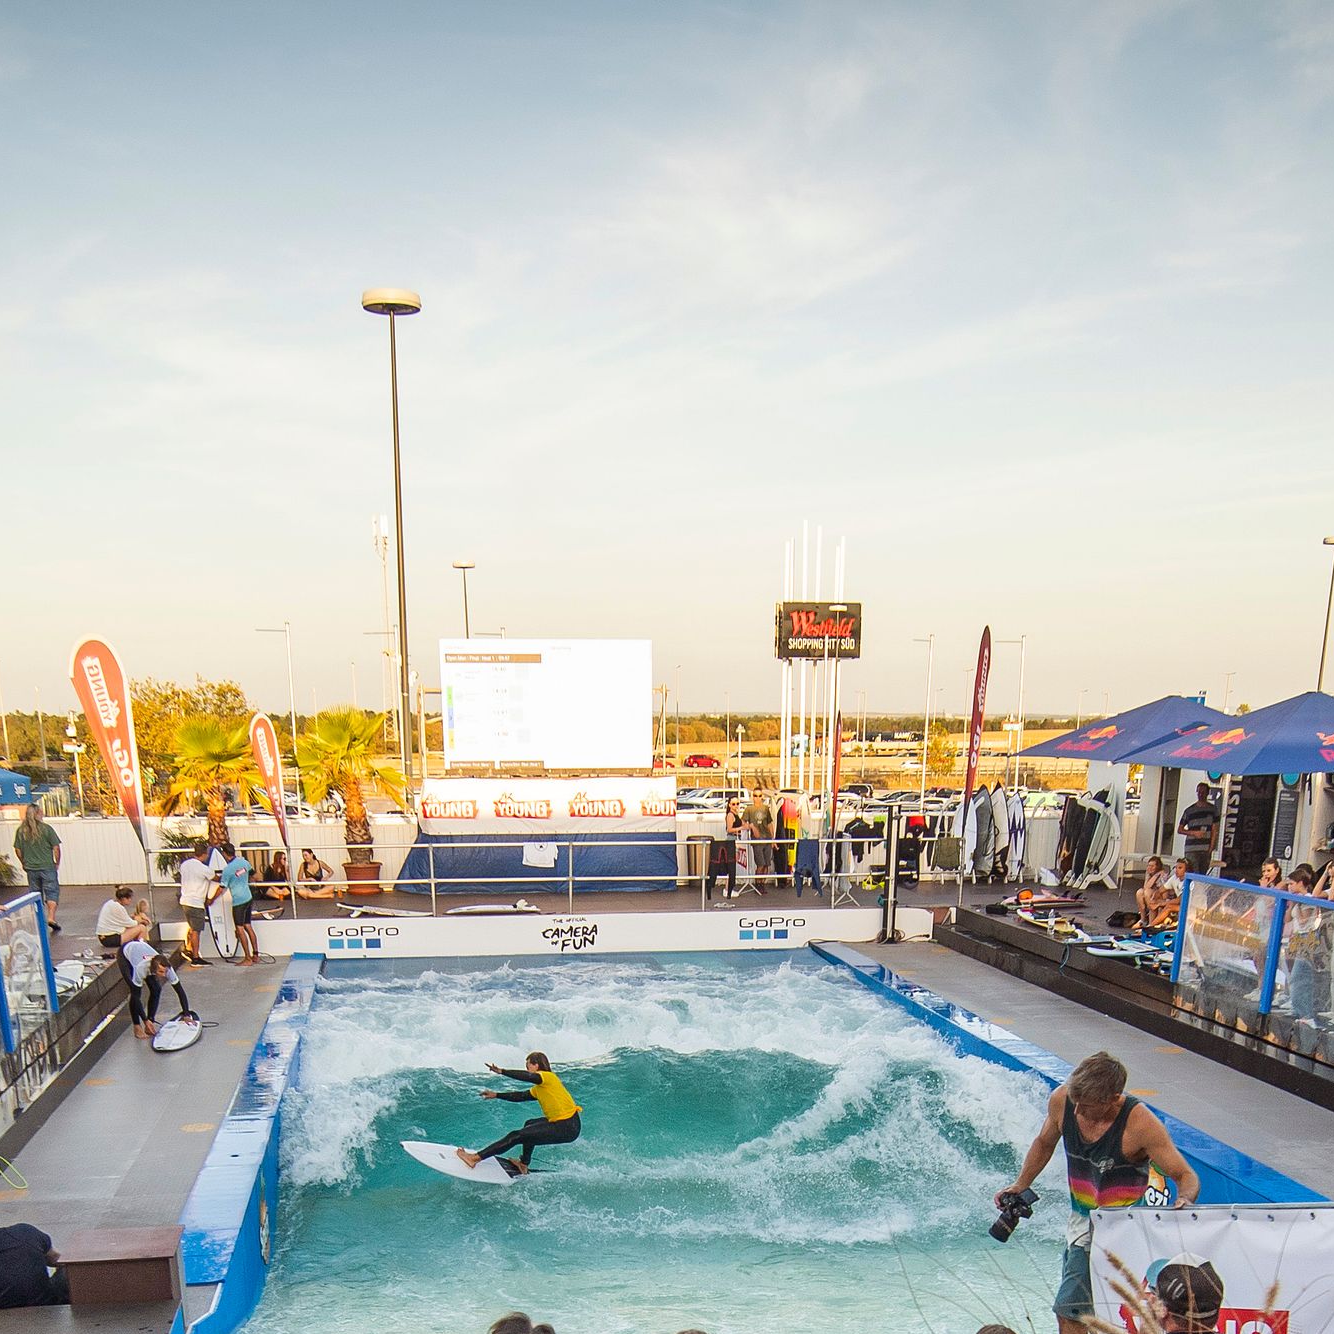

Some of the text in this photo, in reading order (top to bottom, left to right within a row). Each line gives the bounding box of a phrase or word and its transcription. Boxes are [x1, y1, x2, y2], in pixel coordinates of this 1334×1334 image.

[791, 611, 855, 637] Westfield
[788, 638, 823, 650] SHOPPING
[841, 637, 855, 650] SÜD
[424, 801, 474, 818] YOUNG
[497, 801, 549, 818] YOUNG
[571, 801, 622, 817] YOUNG
[739, 917, 806, 928] GoPro
[327, 926, 400, 938] GoPro
[541, 924, 598, 939] CAMERA
[561, 934, 595, 952] FUN
[1144, 1187, 1169, 1207] ezi
